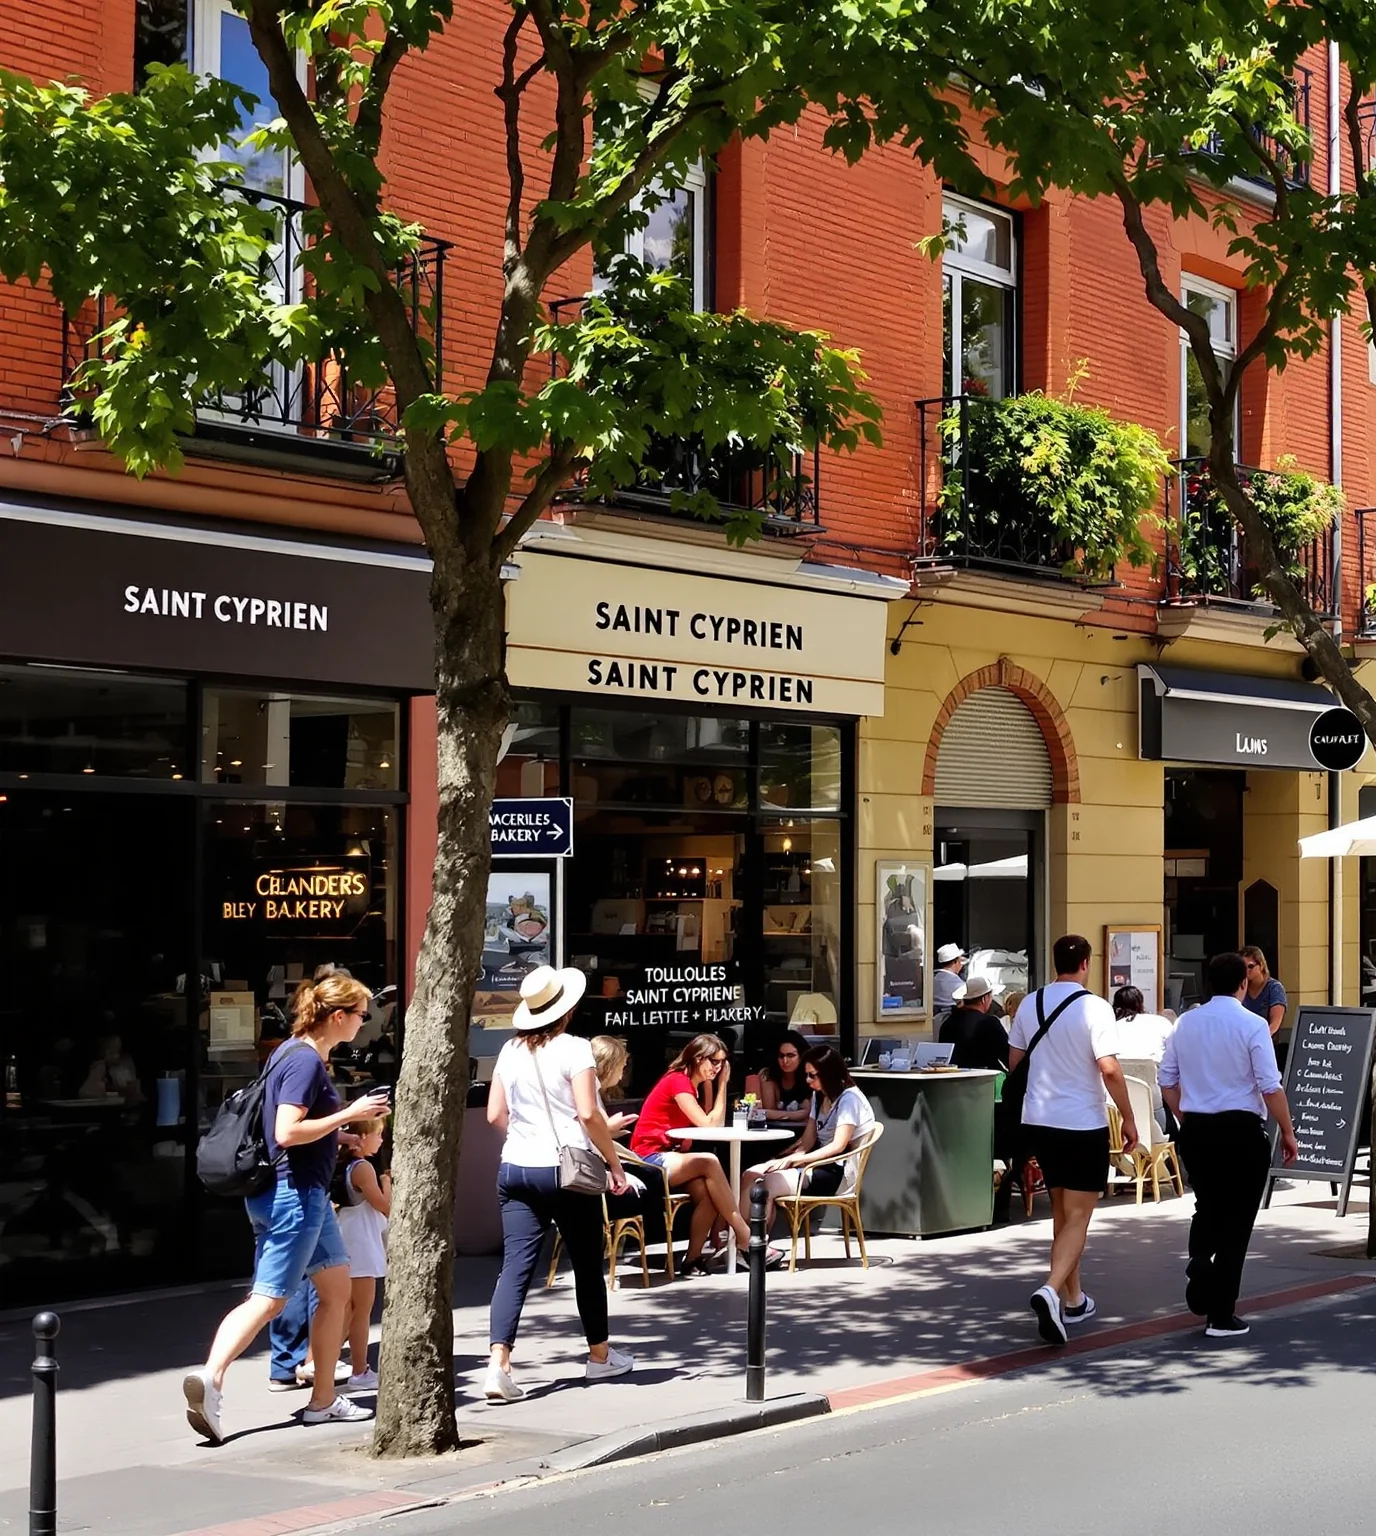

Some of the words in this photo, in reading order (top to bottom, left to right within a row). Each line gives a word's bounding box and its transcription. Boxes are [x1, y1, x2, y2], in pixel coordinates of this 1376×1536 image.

[123, 585, 206, 619] SAINT
[213, 594, 328, 631] CYPRIEN
[595, 601, 680, 636] SAINT
[690, 612, 803, 650] CYPRIEN
[587, 659, 677, 691] SAINT
[693, 669, 813, 703] CYPRIEN
[490, 829, 541, 841] BAKERY
[223, 902, 256, 918] BLEY
[626, 988, 669, 1005] SAINT
[673, 985, 741, 1003] CYPRIENE
